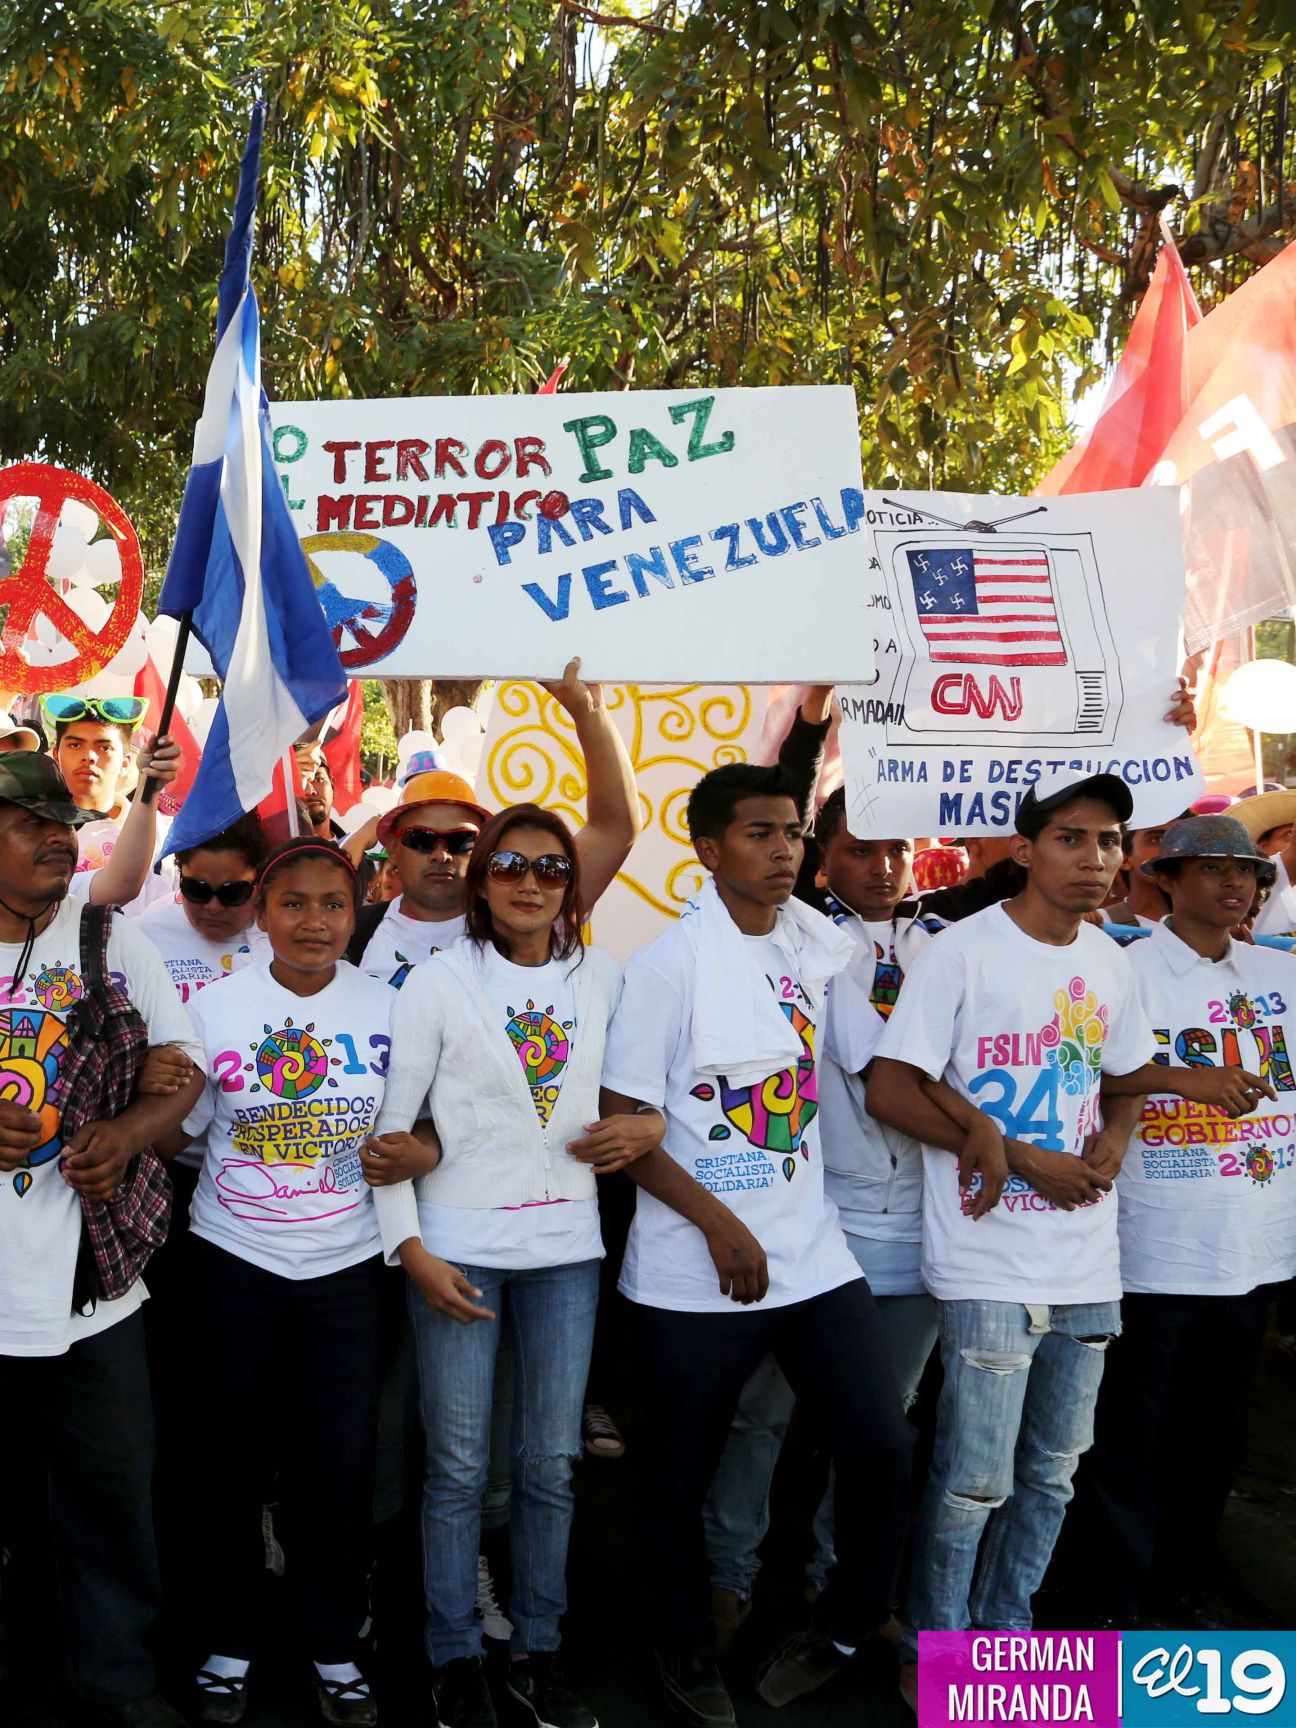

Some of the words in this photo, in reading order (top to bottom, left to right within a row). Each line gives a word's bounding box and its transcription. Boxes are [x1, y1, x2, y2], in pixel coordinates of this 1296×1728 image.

[321, 436, 552, 484] TERROR
[562, 396, 735, 484] PAZ
[315, 489, 572, 532] MEDIATICO
[486, 488, 658, 565] PARA
[521, 487, 865, 622] VENEZUELA
[930, 673, 1023, 721] CNN
[942, 760, 973, 783] DE
[939, 791, 1023, 827] MAS
[977, 1033, 1043, 1069] FSLN
[968, 1068, 1065, 1152] 34
[239, 1142, 264, 1160] EN
[274, 1134, 366, 1160] VICTOR
[698, 1177, 773, 1193] OLIDARIA!
[1145, 1168, 1215, 1179] SOLIDARIA!
